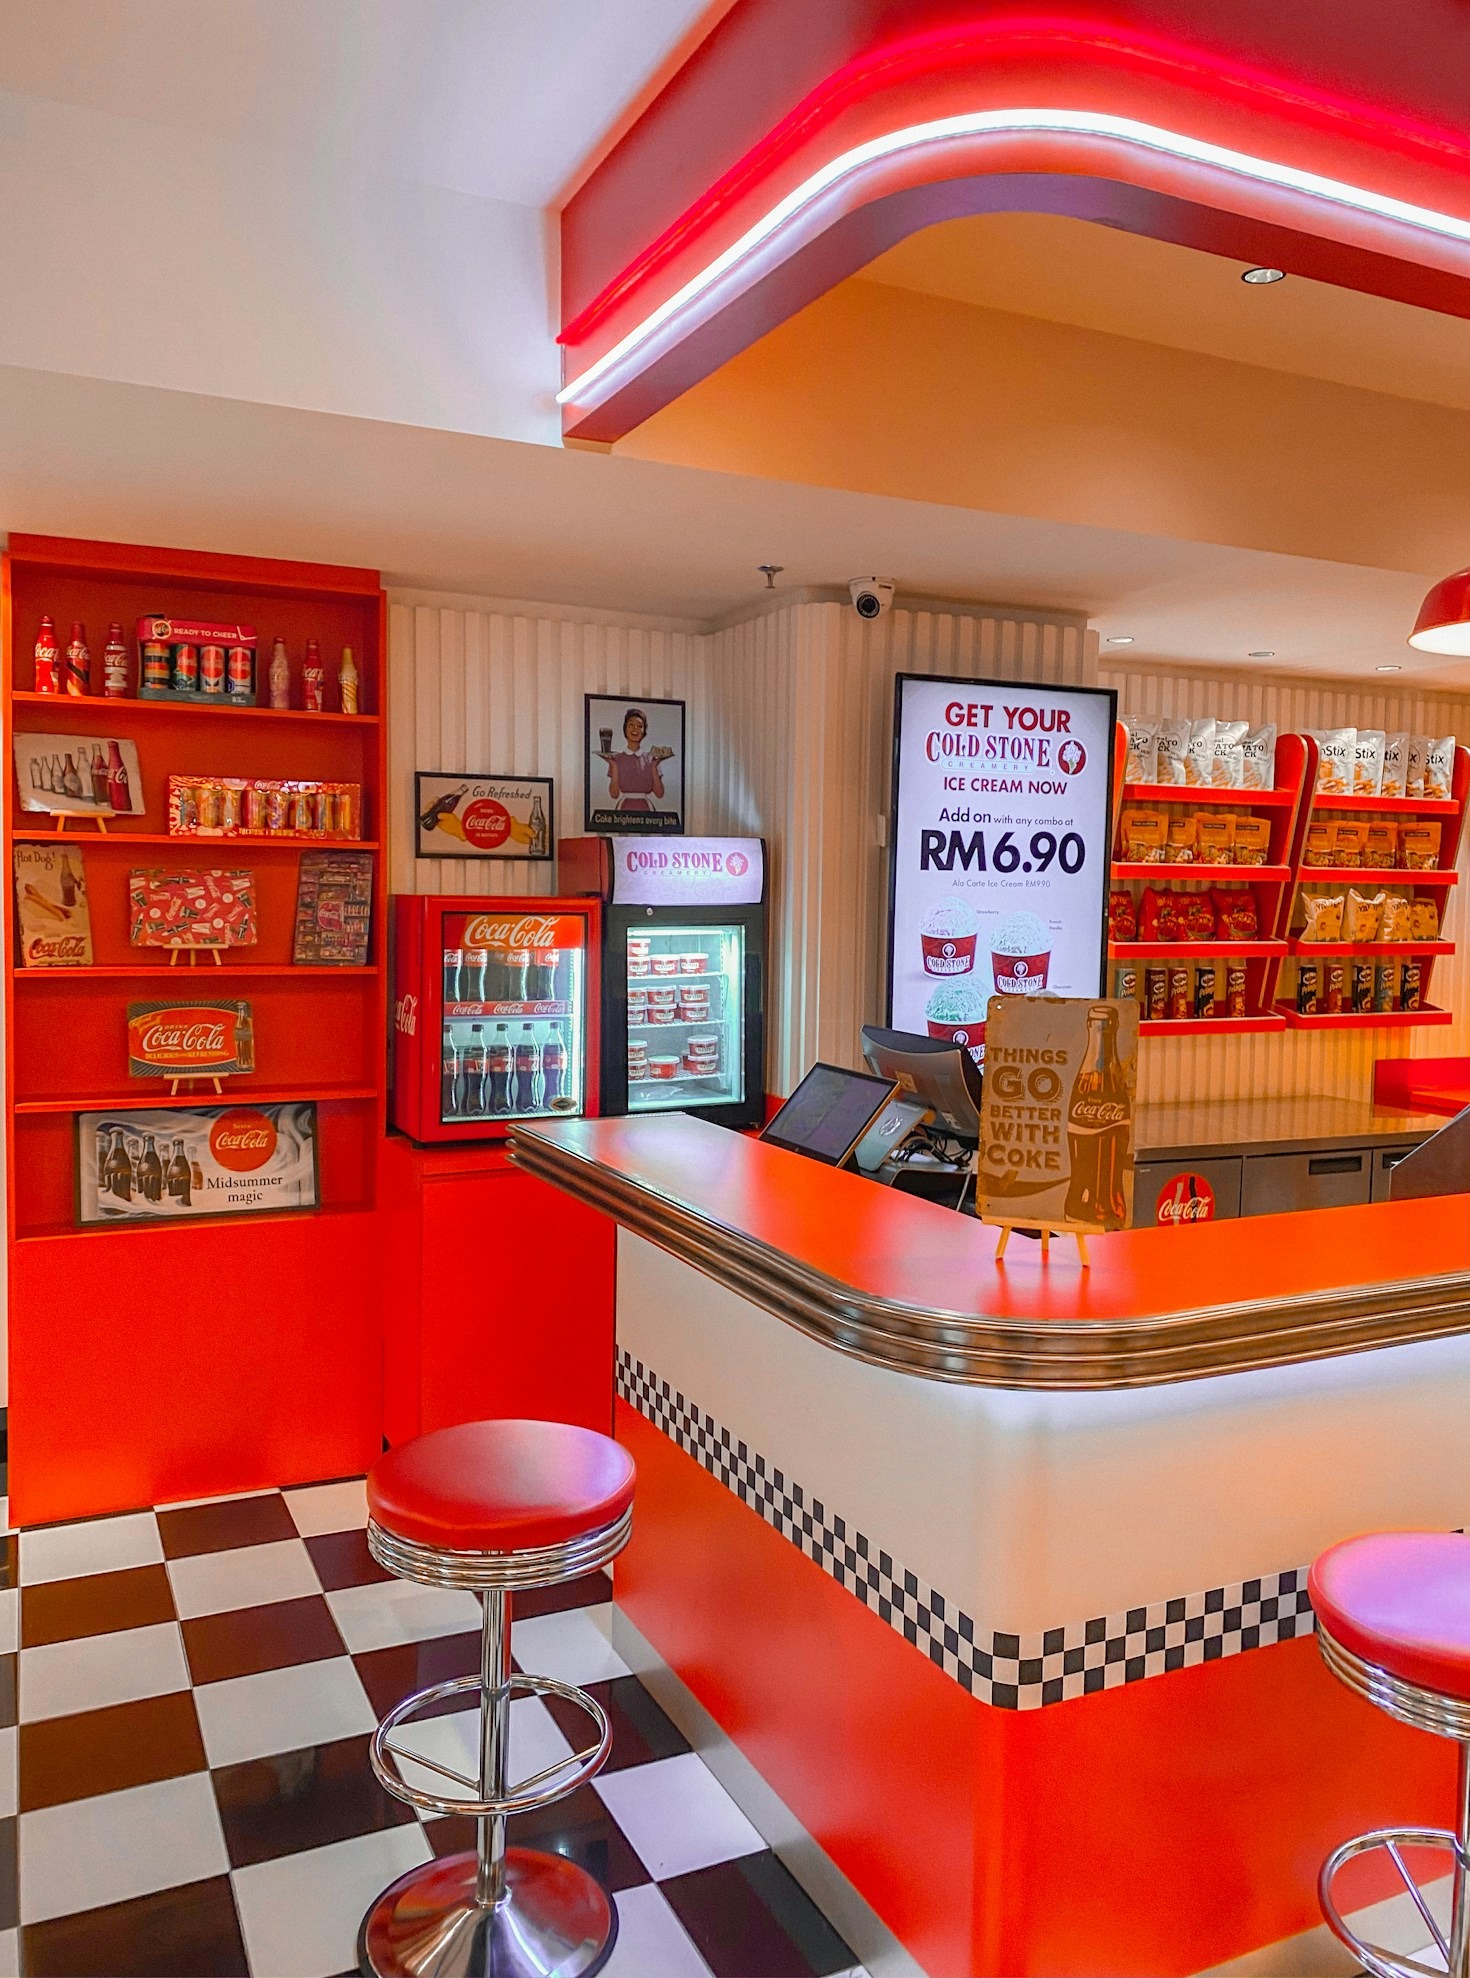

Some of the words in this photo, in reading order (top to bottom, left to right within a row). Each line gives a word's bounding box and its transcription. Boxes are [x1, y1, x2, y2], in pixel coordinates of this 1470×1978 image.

[174, 628, 200, 636] READY
[212, 630, 238, 639] CHEER
[945, 702, 994, 728] GET
[1003, 706, 1071, 733] YOUR
[926, 731, 980, 762] COLD
[985, 734, 1050, 767] STONE
[948, 761, 1029, 771] CREAMERY
[472, 786, 486, 798] Go
[488, 786, 532, 800] Refreshed
[944, 776, 966, 790] ICE
[970, 778, 1023, 793] CREAM
[1028, 780, 1068, 794] NOW
[466, 814, 508, 831] Coca-Cola
[594, 813, 612, 824] Coke
[614, 816, 644, 827] brightens
[646, 818, 663, 827] every
[664, 816, 677, 826] bite
[938, 806, 970, 822] Add
[974, 812, 992, 823] on
[994, 815, 1012, 824] with
[1016, 818, 1032, 828] any
[1034, 816, 1064, 826] combo
[16, 850, 32, 868] Hot
[34, 851, 56, 871] Dog!
[920, 828, 1086, 874] RM6.90
[626, 851, 668, 872] COLD
[672, 852, 723, 873] STONE
[952, 880, 964, 888] Ala
[966, 880, 986, 888] Carte
[988, 880, 998, 888] Ice
[1000, 880, 1024, 888] Cream
[464, 915, 560, 948] Coca-Cola
[28, 936, 87, 960] Coca-Cola
[927, 956, 946, 968] COLD
[946, 956, 970, 968] STONE
[998, 976, 1016, 988] COLD
[1016, 974, 1043, 988] STONE
[452, 1004, 484, 1015] Coca-Cola
[494, 1004, 524, 1014] Coca-Cola
[142, 1024, 226, 1052] Coca-Cola
[990, 1047, 1069, 1066] THINGS
[992, 1065, 1063, 1103] GO
[990, 1104, 1062, 1122] BETTER
[1072, 1101, 1126, 1120] Coca-Cola
[216, 1130, 270, 1150] Coca-Cola
[990, 1122, 1060, 1144] WITH
[986, 1143, 1061, 1170] COKE
[207, 1176, 284, 1190] Midsummer
[228, 1190, 264, 1204] magic
[1158, 1196, 1212, 1222] Coca-Cola
